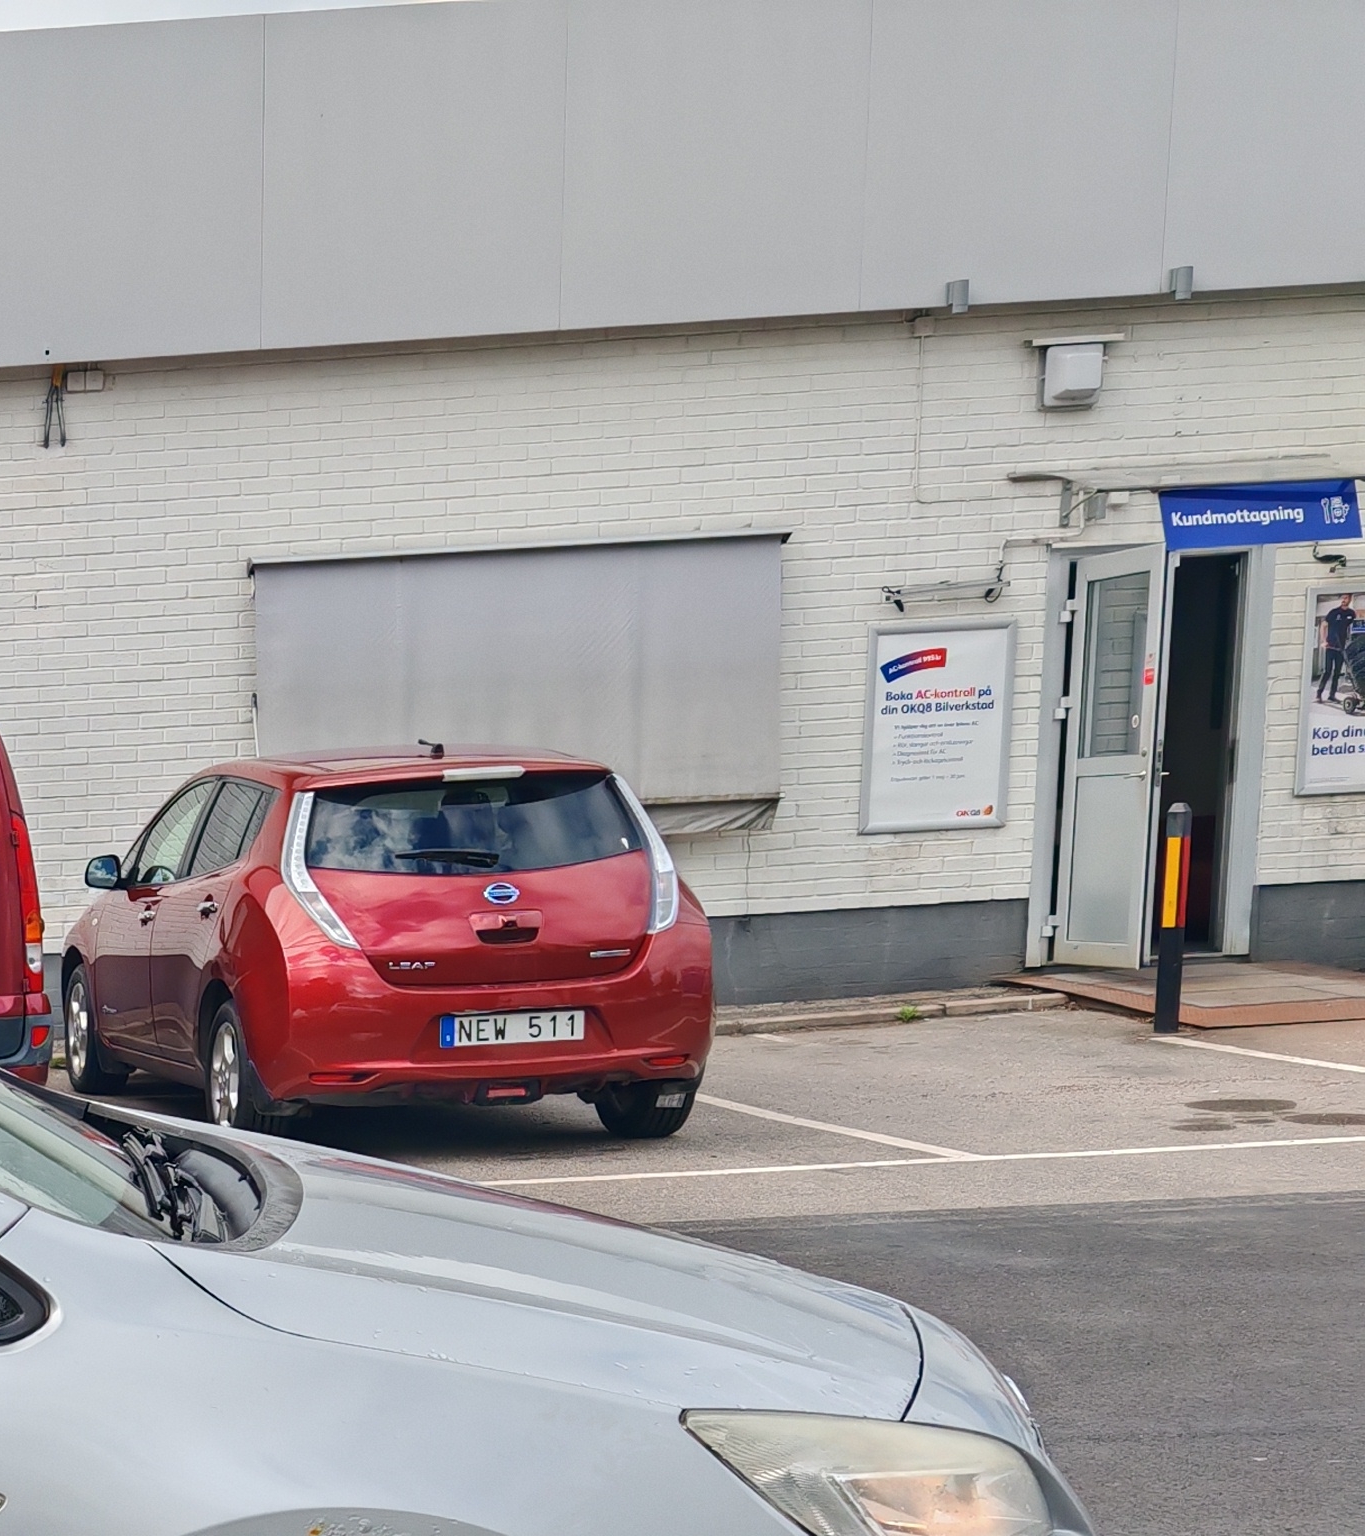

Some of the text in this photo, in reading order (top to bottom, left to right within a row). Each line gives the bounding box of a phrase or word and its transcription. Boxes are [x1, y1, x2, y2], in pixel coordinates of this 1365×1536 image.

[1171, 505, 1305, 527] Kundmottagning
[885, 685, 993, 702] Boka AC-kontroll på
[880, 699, 995, 716] din OKQ8 Bilverkstad
[1312, 724, 1365, 742] Köp din
[1311, 742, 1365, 756] betala s
[388, 961, 436, 970] LEAF
[458, 1017, 506, 1042] NEW
[528, 1014, 576, 1039] 511
